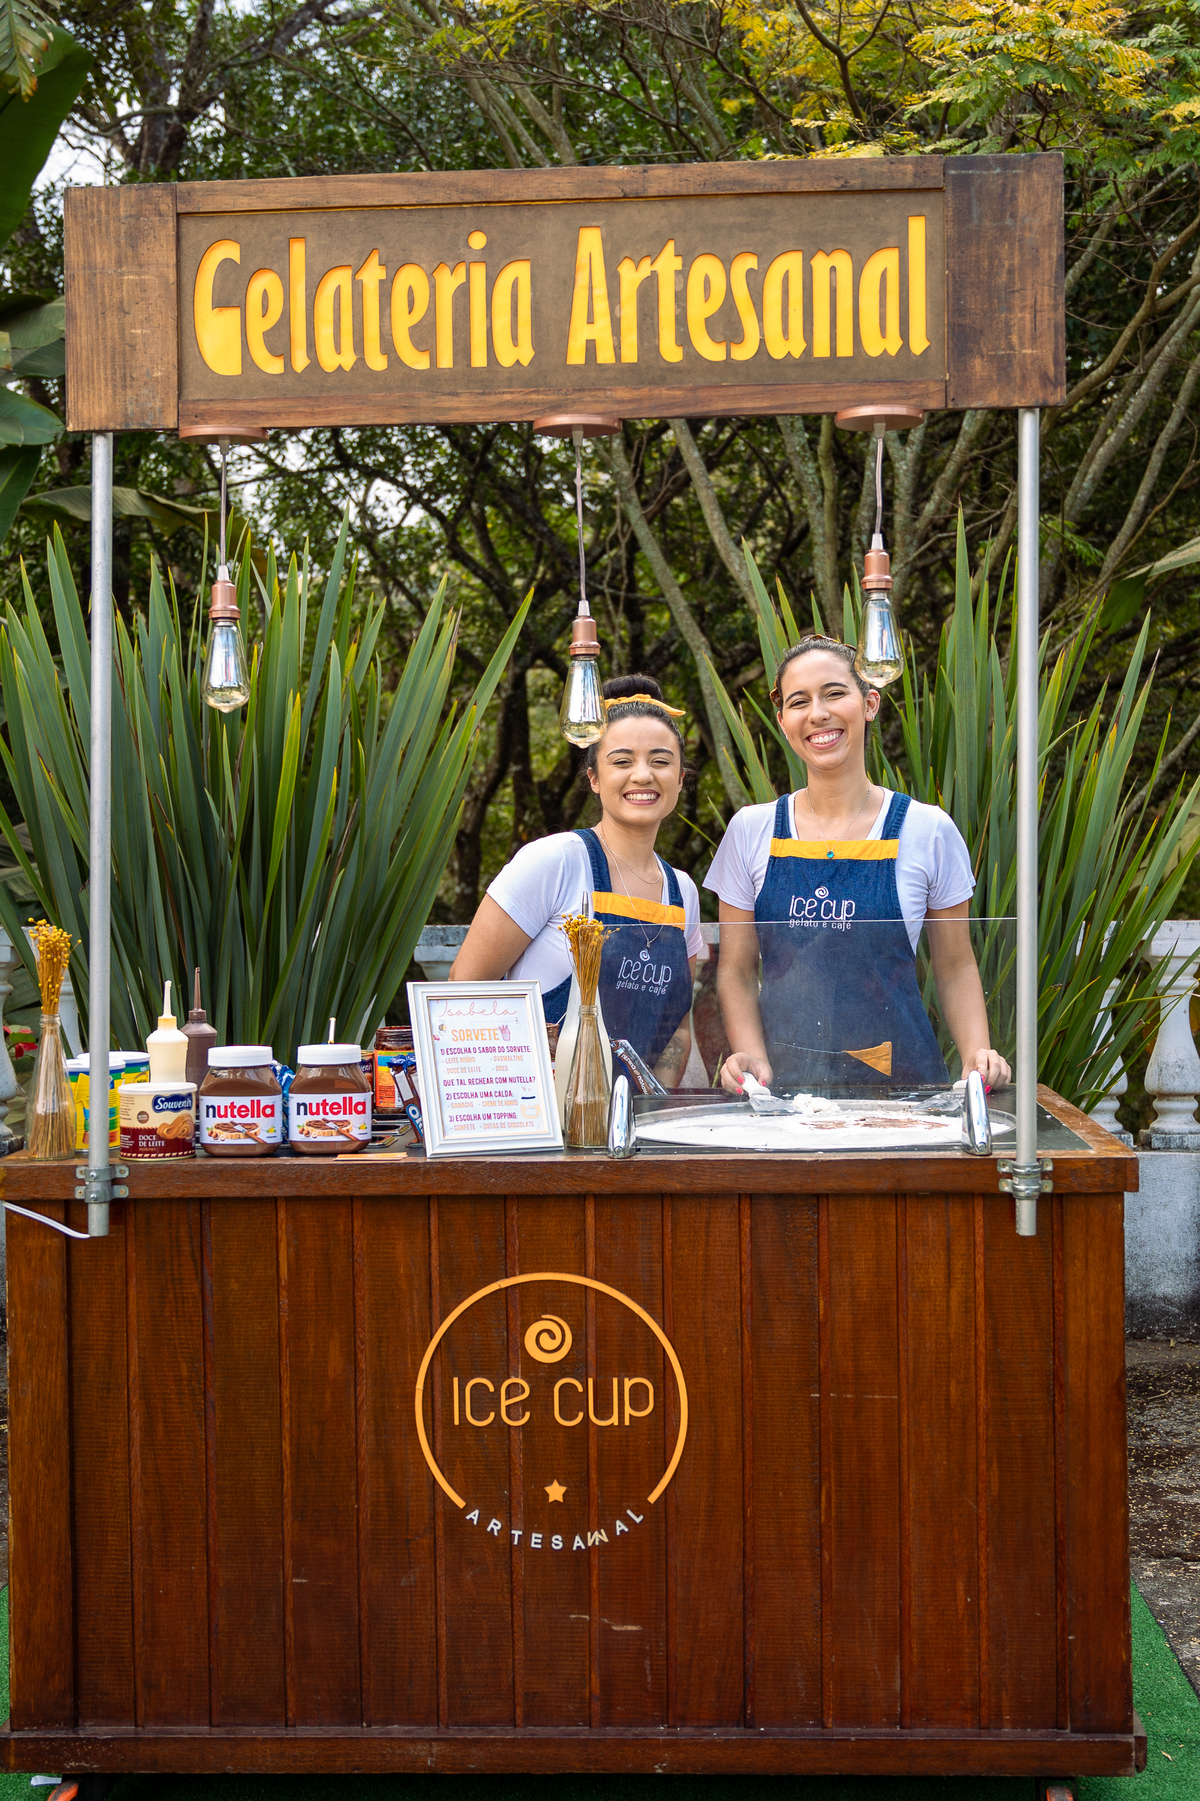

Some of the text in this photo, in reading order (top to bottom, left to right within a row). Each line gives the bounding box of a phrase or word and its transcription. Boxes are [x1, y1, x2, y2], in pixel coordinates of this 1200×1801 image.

[193, 214, 932, 376] Gelateria Artesanal
[821, 899, 855, 920] cup
[789, 918, 819, 929] gelato
[832, 919, 852, 932] café
[642, 963, 672, 985] cup
[616, 980, 640, 990] gelato
[648, 984, 668, 996] café
[452, 1028, 499, 1042] SORVETE
[446, 1047, 472, 1055] ESCOLHA
[478, 1046, 496, 1054] SABOR
[456, 1078, 466, 1086] TAL
[508, 1076, 536, 1084] NUTELLA?
[453, 1092, 478, 1100] ESCOLHA
[206, 1100, 275, 1118] nutella
[296, 1096, 366, 1116] nutella
[456, 1114, 482, 1122] ESCOLHA
